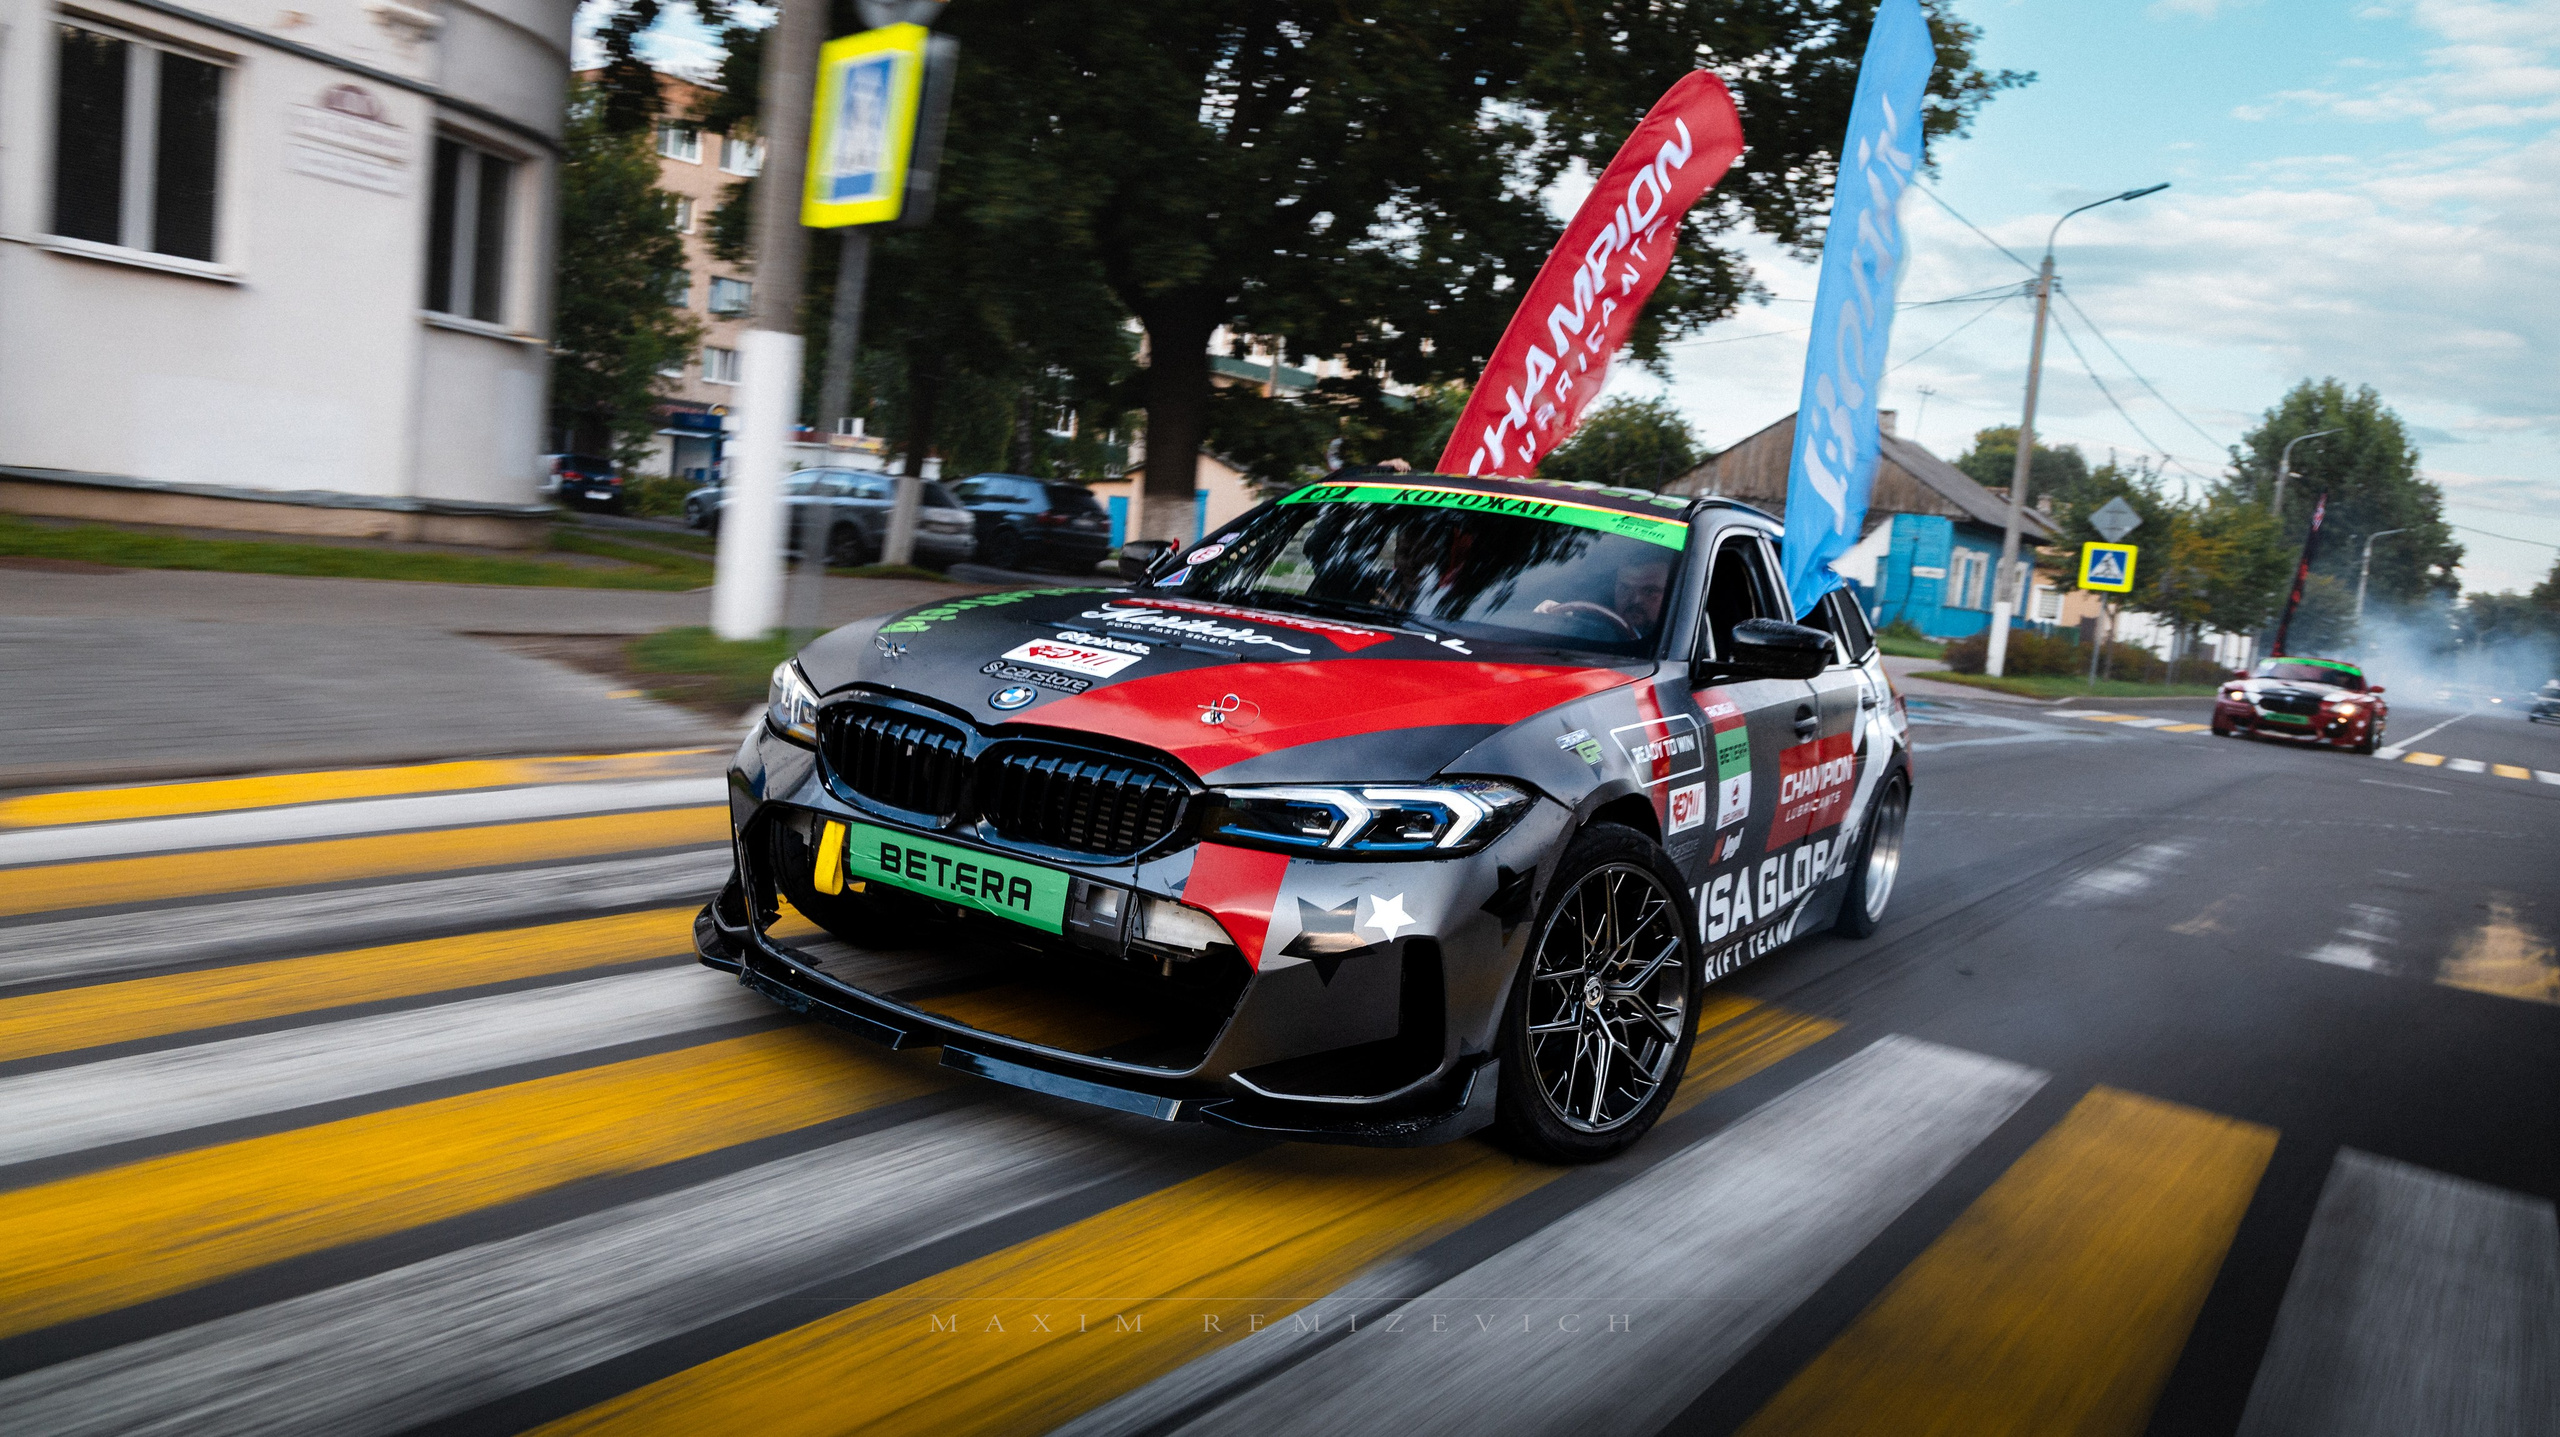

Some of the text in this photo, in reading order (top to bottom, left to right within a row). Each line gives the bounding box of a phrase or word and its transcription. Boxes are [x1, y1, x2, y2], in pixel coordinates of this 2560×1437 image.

[1392, 488, 1560, 518] КОРОЖАН
[1001, 666, 1089, 691] carstore
[1780, 753, 1854, 805] CHAMPION
[1688, 866, 1753, 945] ISA
[1703, 941, 1744, 983] RIFT
